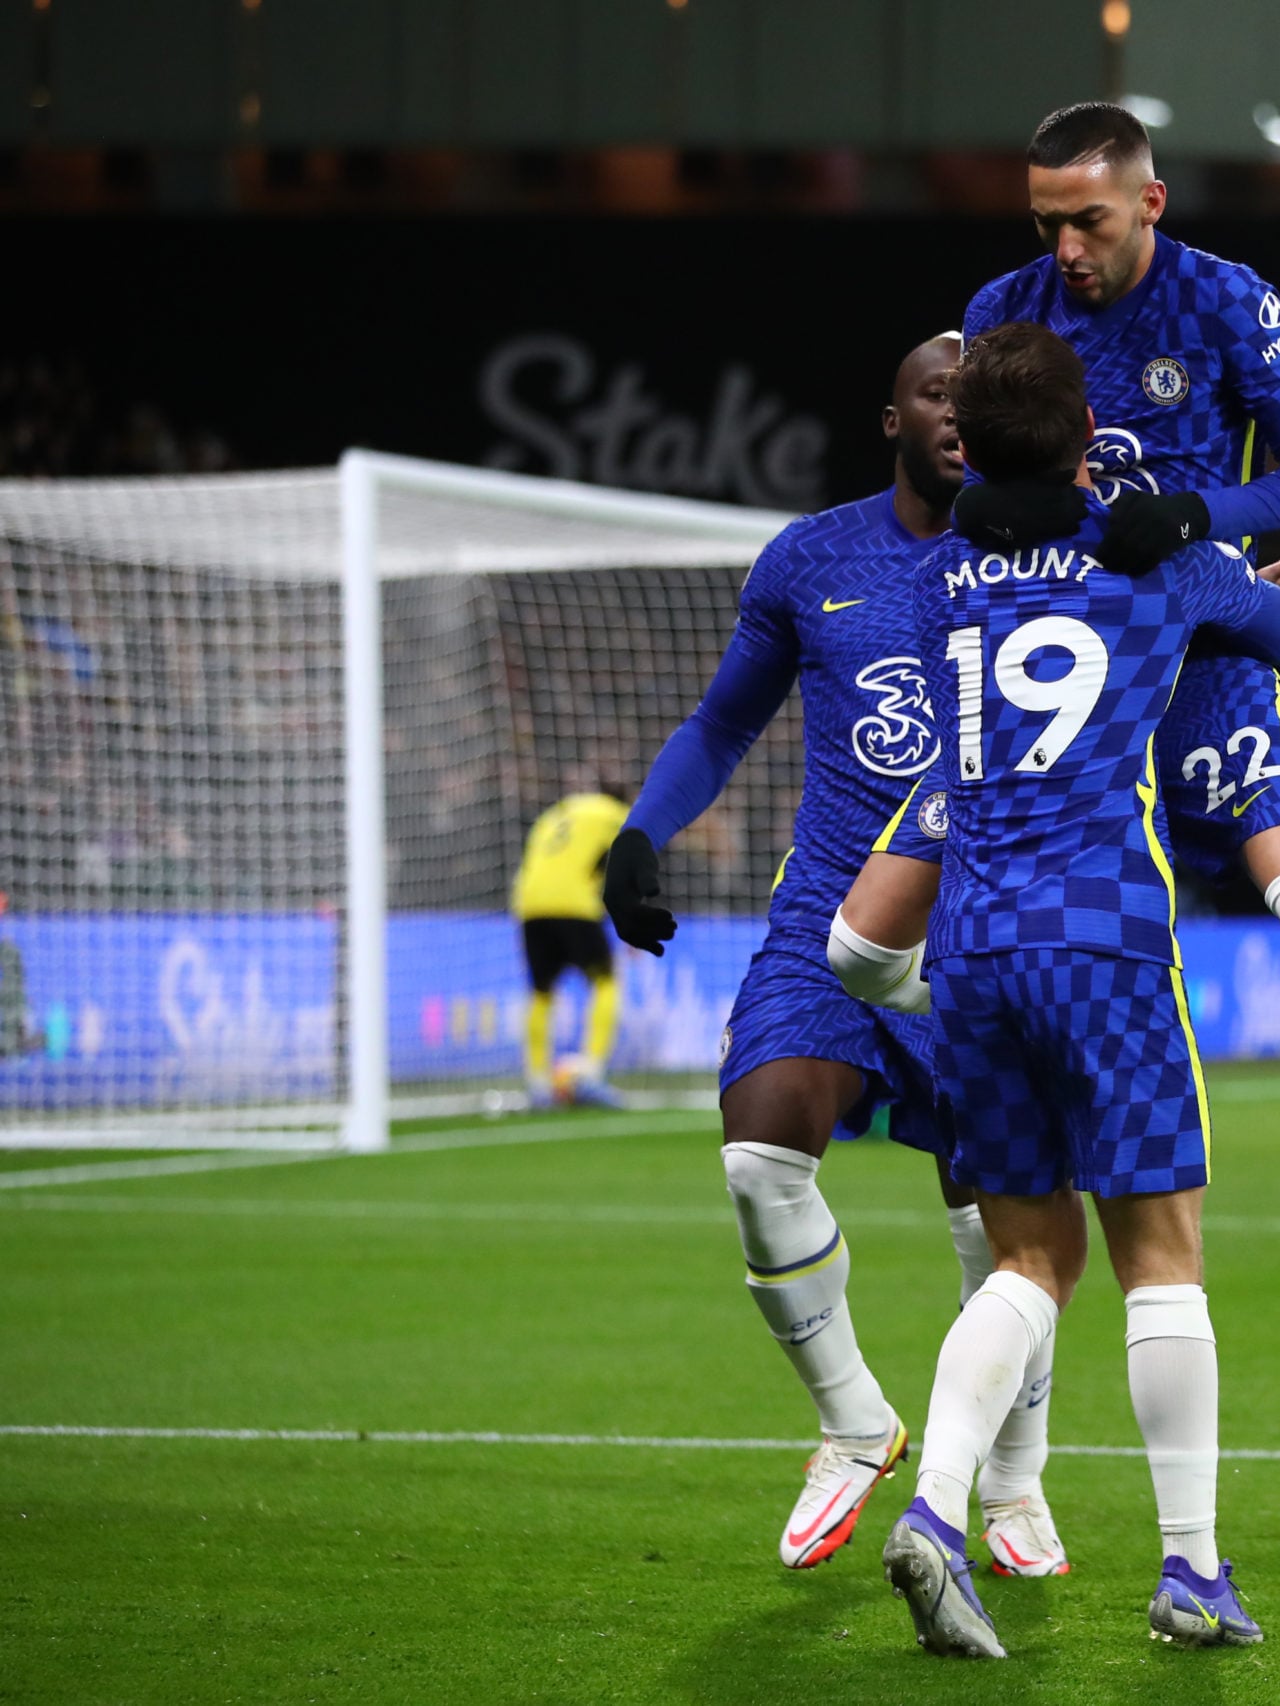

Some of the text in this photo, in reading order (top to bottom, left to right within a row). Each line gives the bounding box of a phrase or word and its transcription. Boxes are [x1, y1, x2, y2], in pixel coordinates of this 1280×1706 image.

[478, 333, 830, 508] Stake
[944, 547, 1104, 599] MOUNT
[945, 616, 1109, 782] 19
[790, 1307, 833, 1332] CFC
